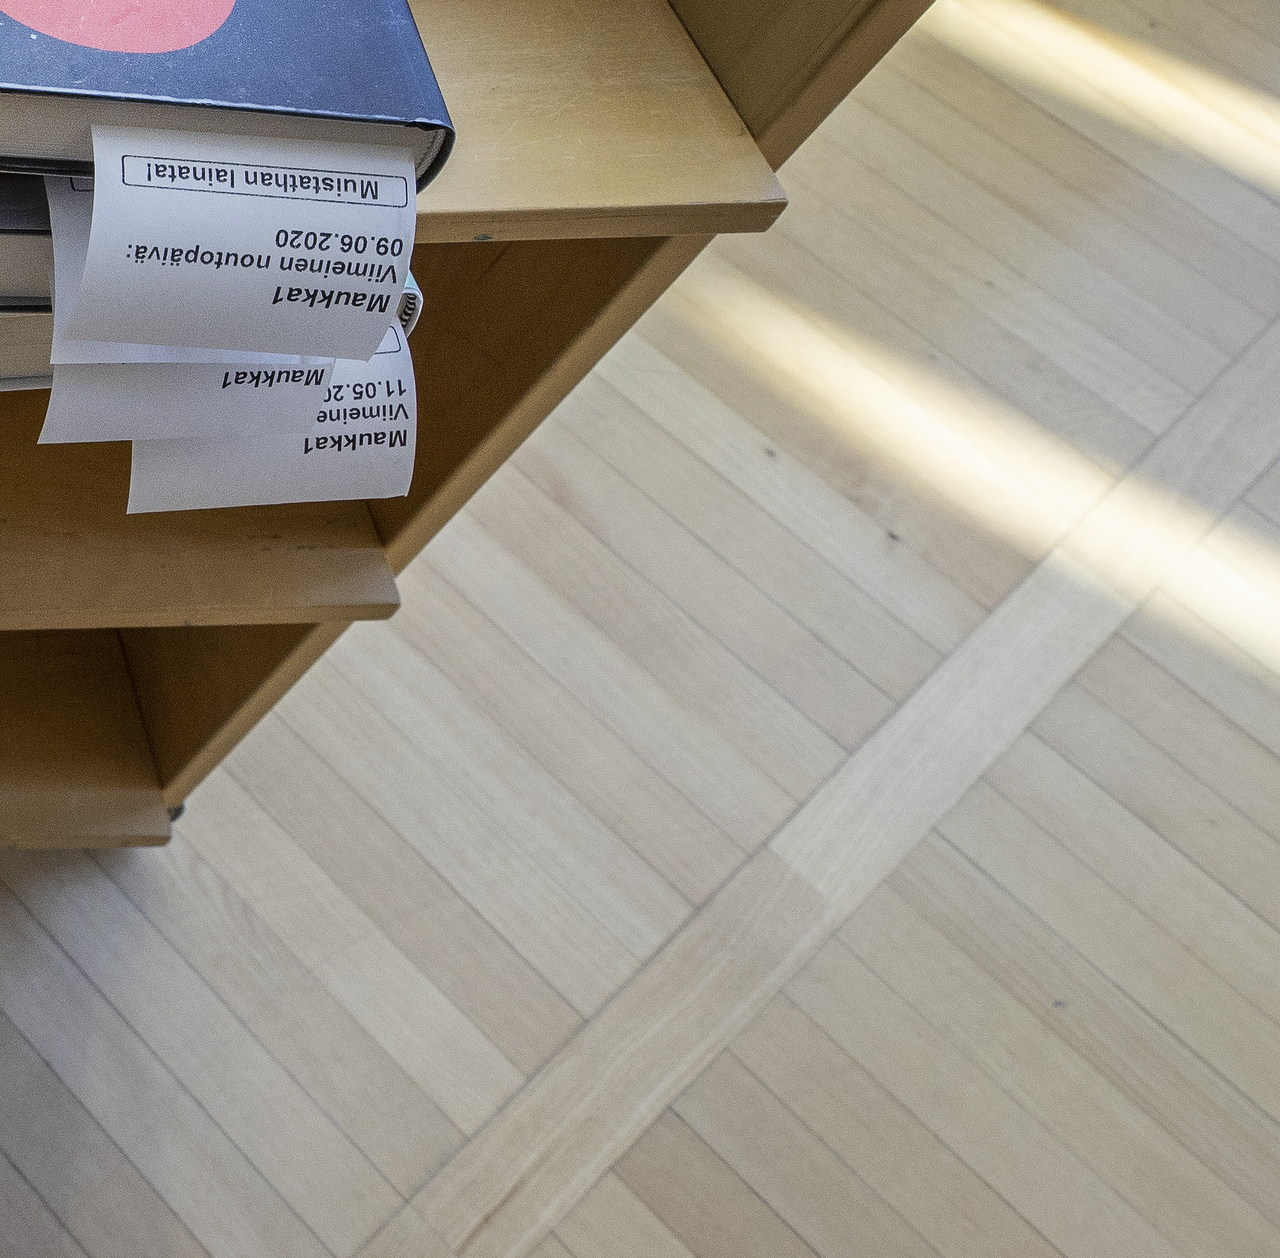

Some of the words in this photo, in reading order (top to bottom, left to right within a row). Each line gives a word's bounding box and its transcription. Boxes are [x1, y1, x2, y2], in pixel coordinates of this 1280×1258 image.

[146, 163, 235, 188] lainata!
[244, 170, 379, 200] Muistathan
[276, 229, 403, 257] 09.06.2020
[127, 244, 271, 271] noutopäivä:
[279, 256, 398, 283] Viimeinen
[272, 286, 391, 313] Maukka1
[221, 369, 324, 388] Maukka1
[316, 403, 409, 424] Viimeine
[303, 430, 408, 454] Maukka1
